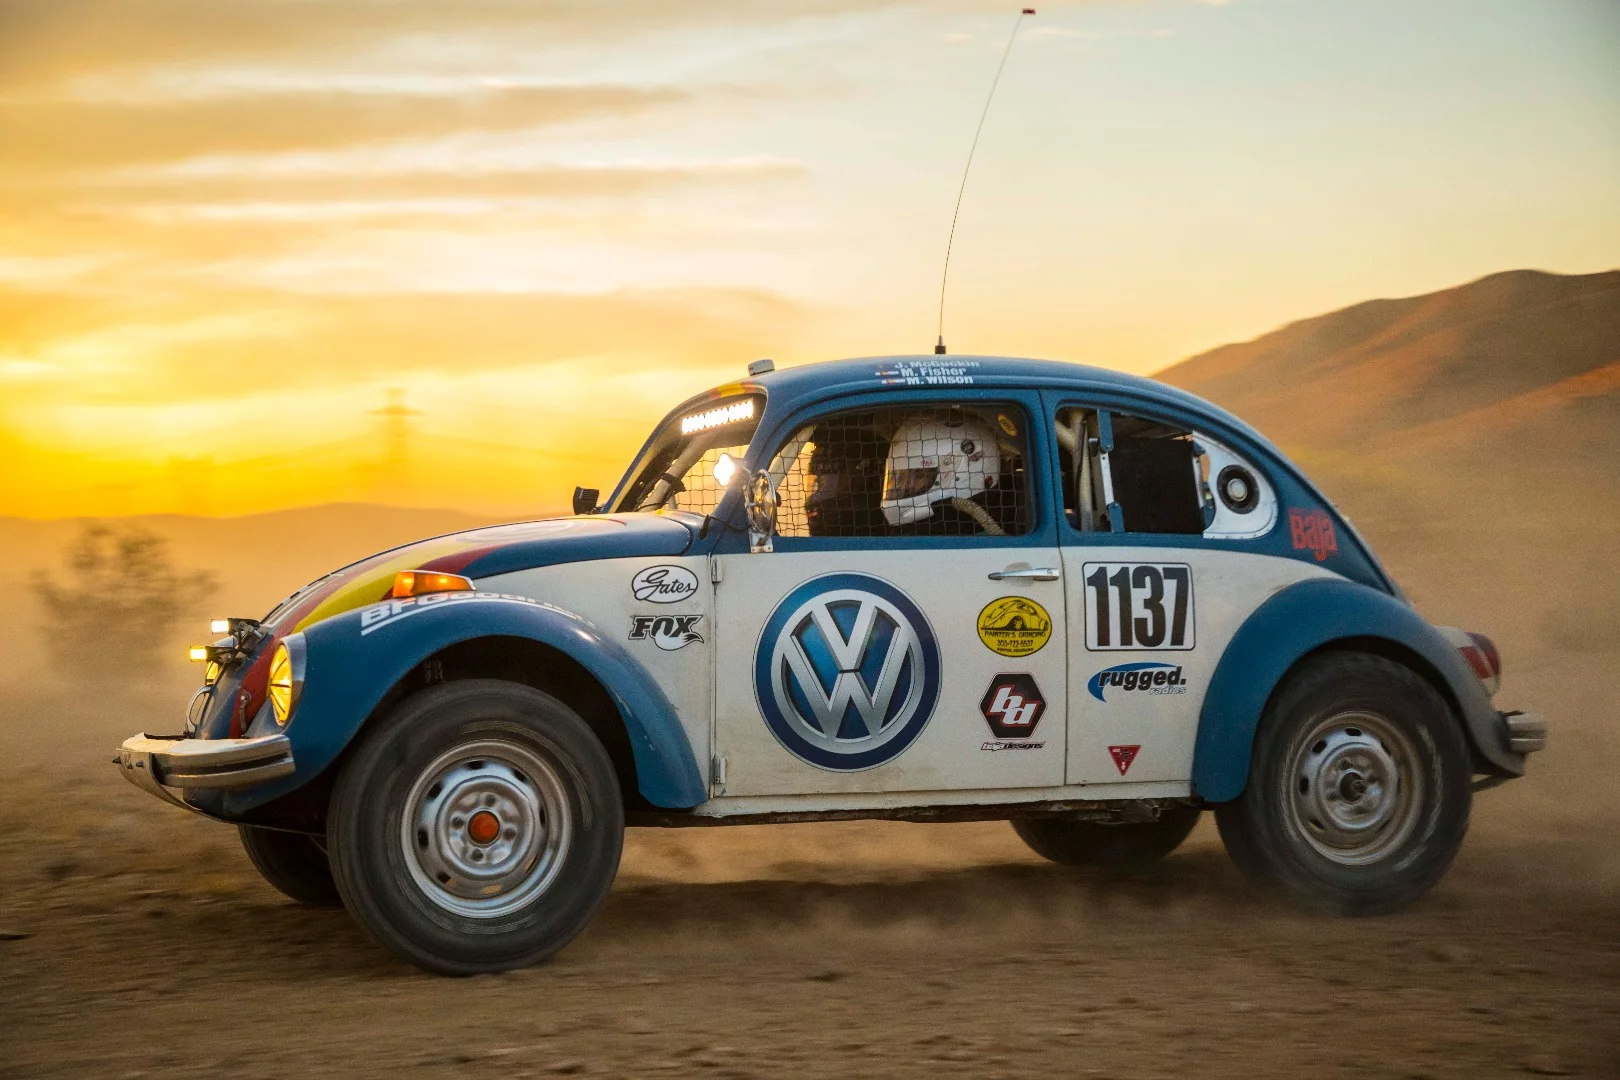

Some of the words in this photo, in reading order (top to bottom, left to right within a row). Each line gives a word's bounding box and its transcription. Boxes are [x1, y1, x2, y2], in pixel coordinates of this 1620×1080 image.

[900, 368, 918, 377] M.
[919, 367, 967, 376] Fisher
[907, 376, 925, 385] M.
[925, 375, 974, 384] Wilson
[634, 569, 693, 600] Gates
[361, 591, 583, 628] BFGoodr
[1086, 565, 1189, 648] 1137
[629, 615, 703, 640] FOX
[1148, 685, 1187, 696] radios
